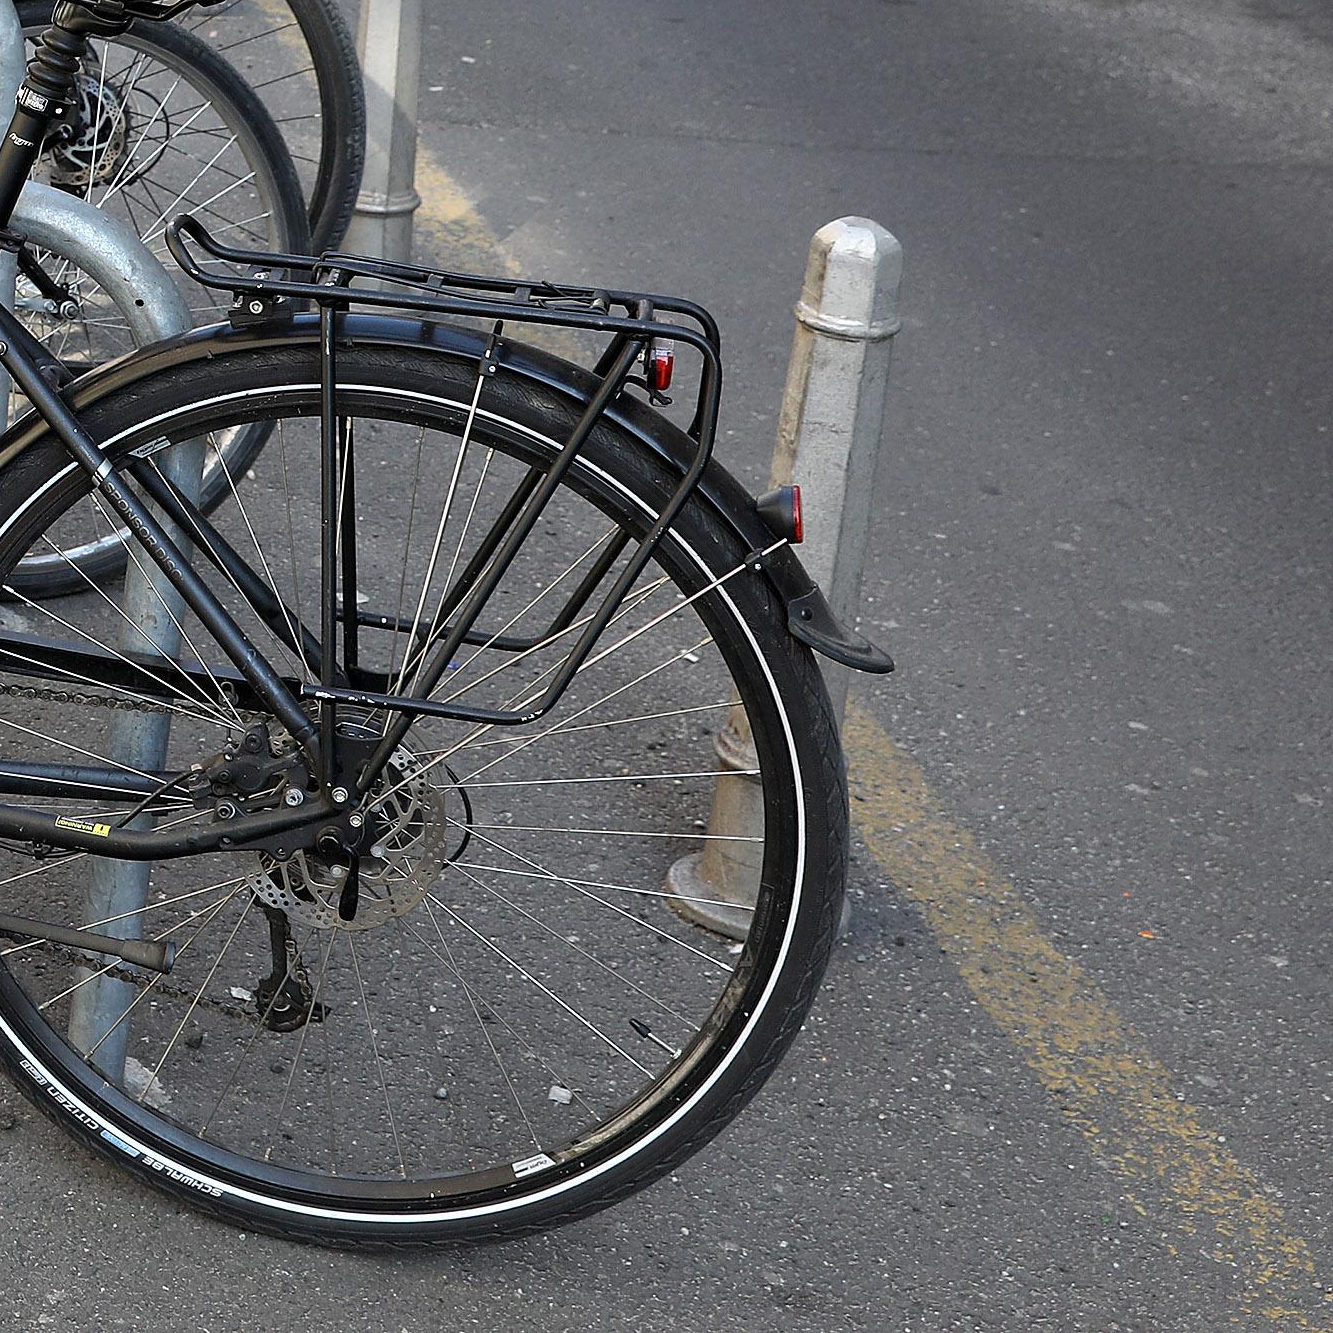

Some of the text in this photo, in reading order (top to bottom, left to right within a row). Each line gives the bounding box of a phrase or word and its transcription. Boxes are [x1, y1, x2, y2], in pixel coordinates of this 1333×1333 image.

[104, 481, 184, 581] SPONSOR DISC
[46, 1085, 100, 1131] CITIZEN
[141, 1156, 225, 1199] SCHWALBE
